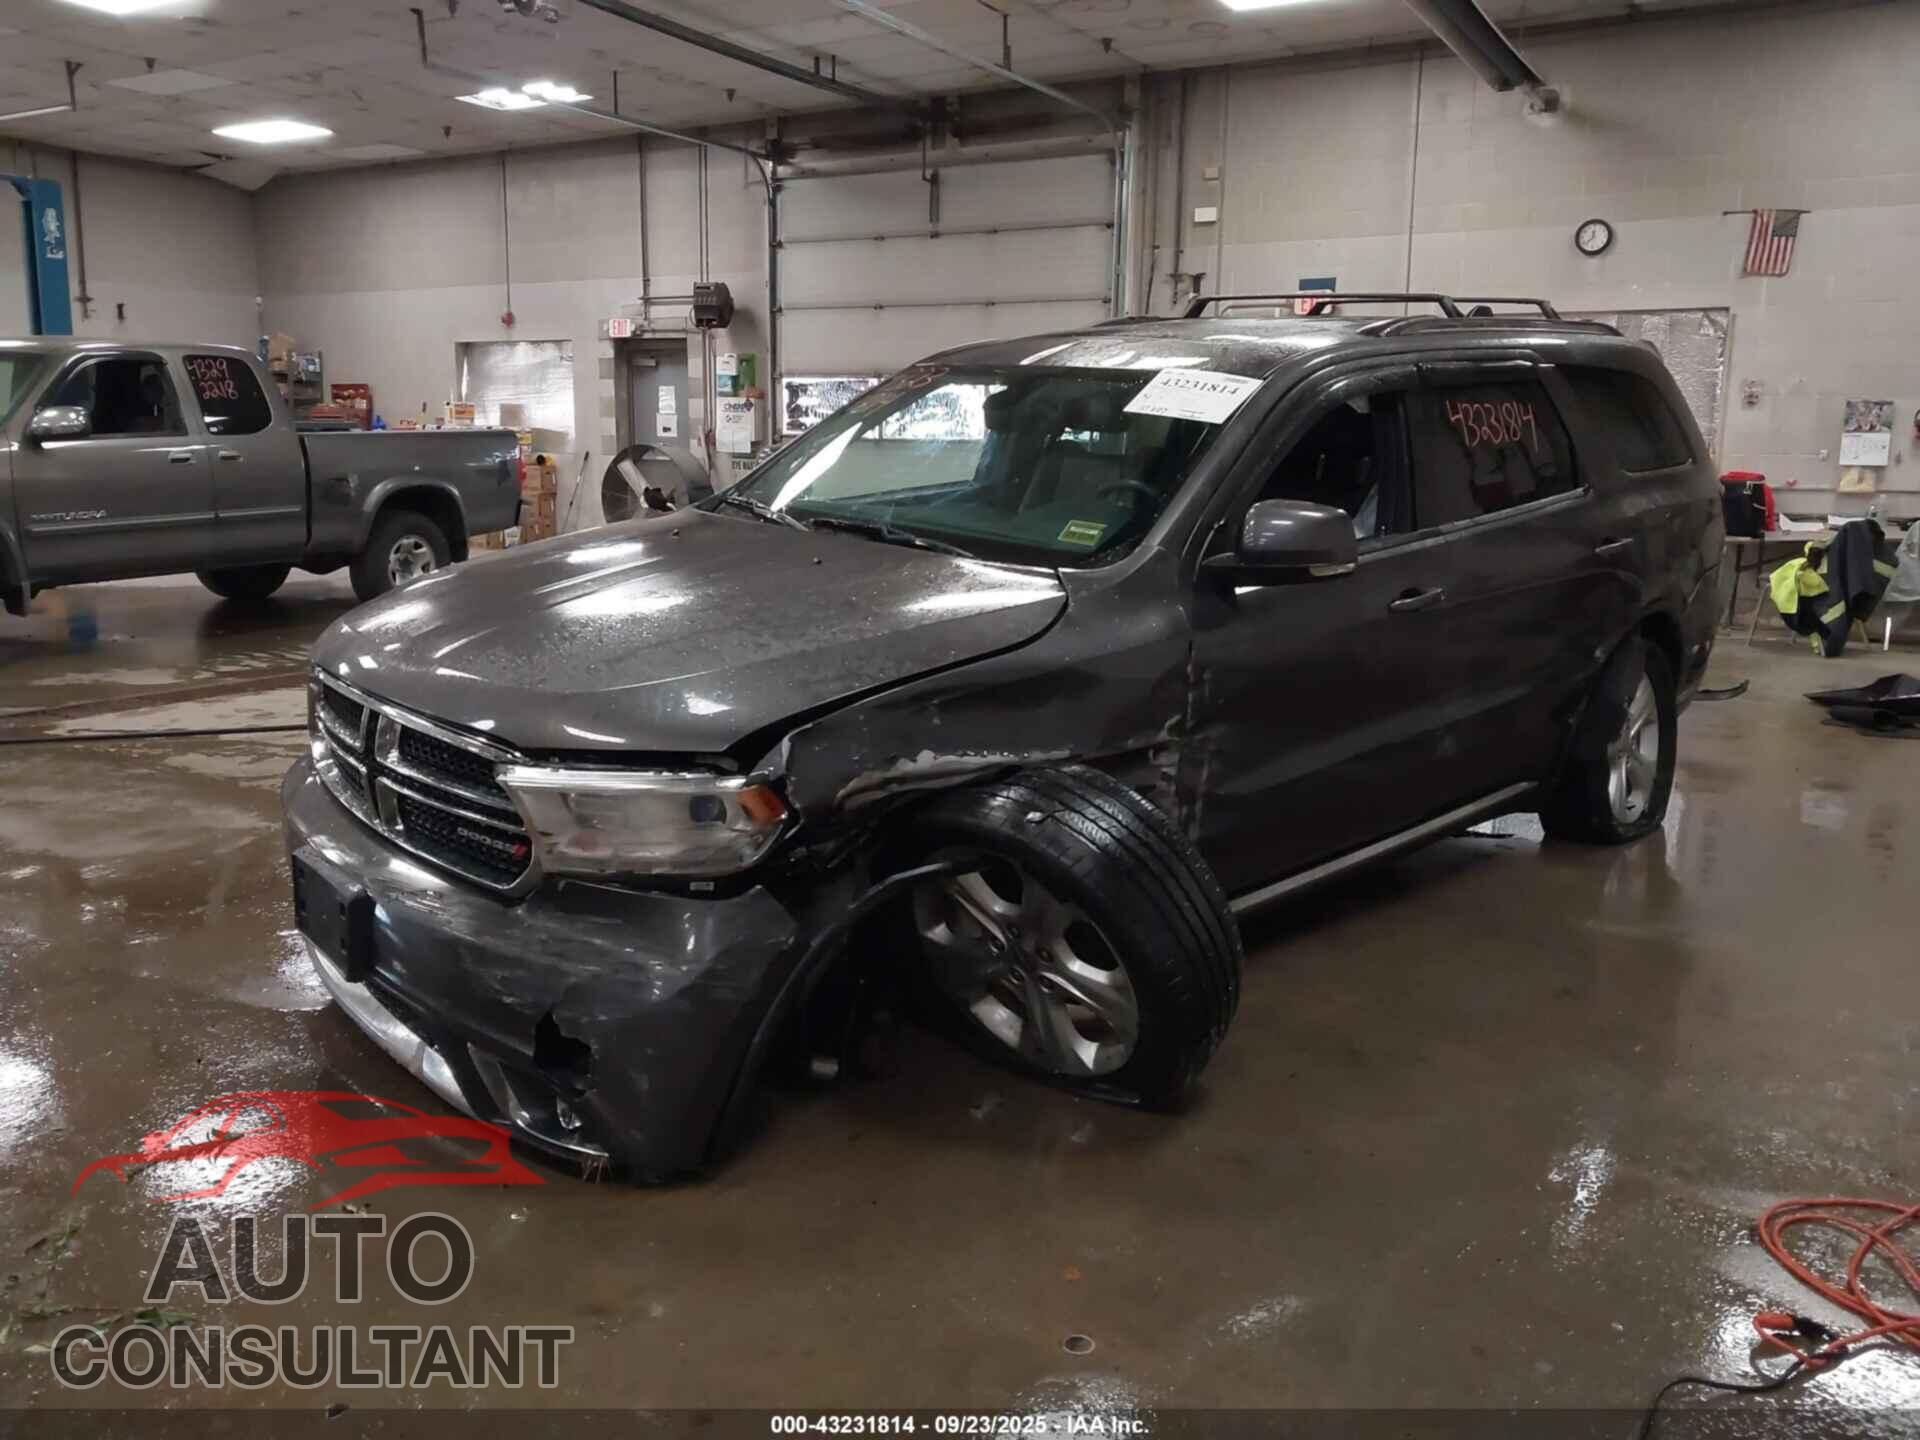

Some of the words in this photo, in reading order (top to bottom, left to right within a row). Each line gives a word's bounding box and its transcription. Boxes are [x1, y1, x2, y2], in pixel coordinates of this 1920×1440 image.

[612, 320, 628, 336] EXIT
[186, 358, 229, 379] 4329
[1161, 378, 1239, 395] 43231814
[1446, 400, 1538, 453] 43231814
[457, 827, 512, 854] DODGE
